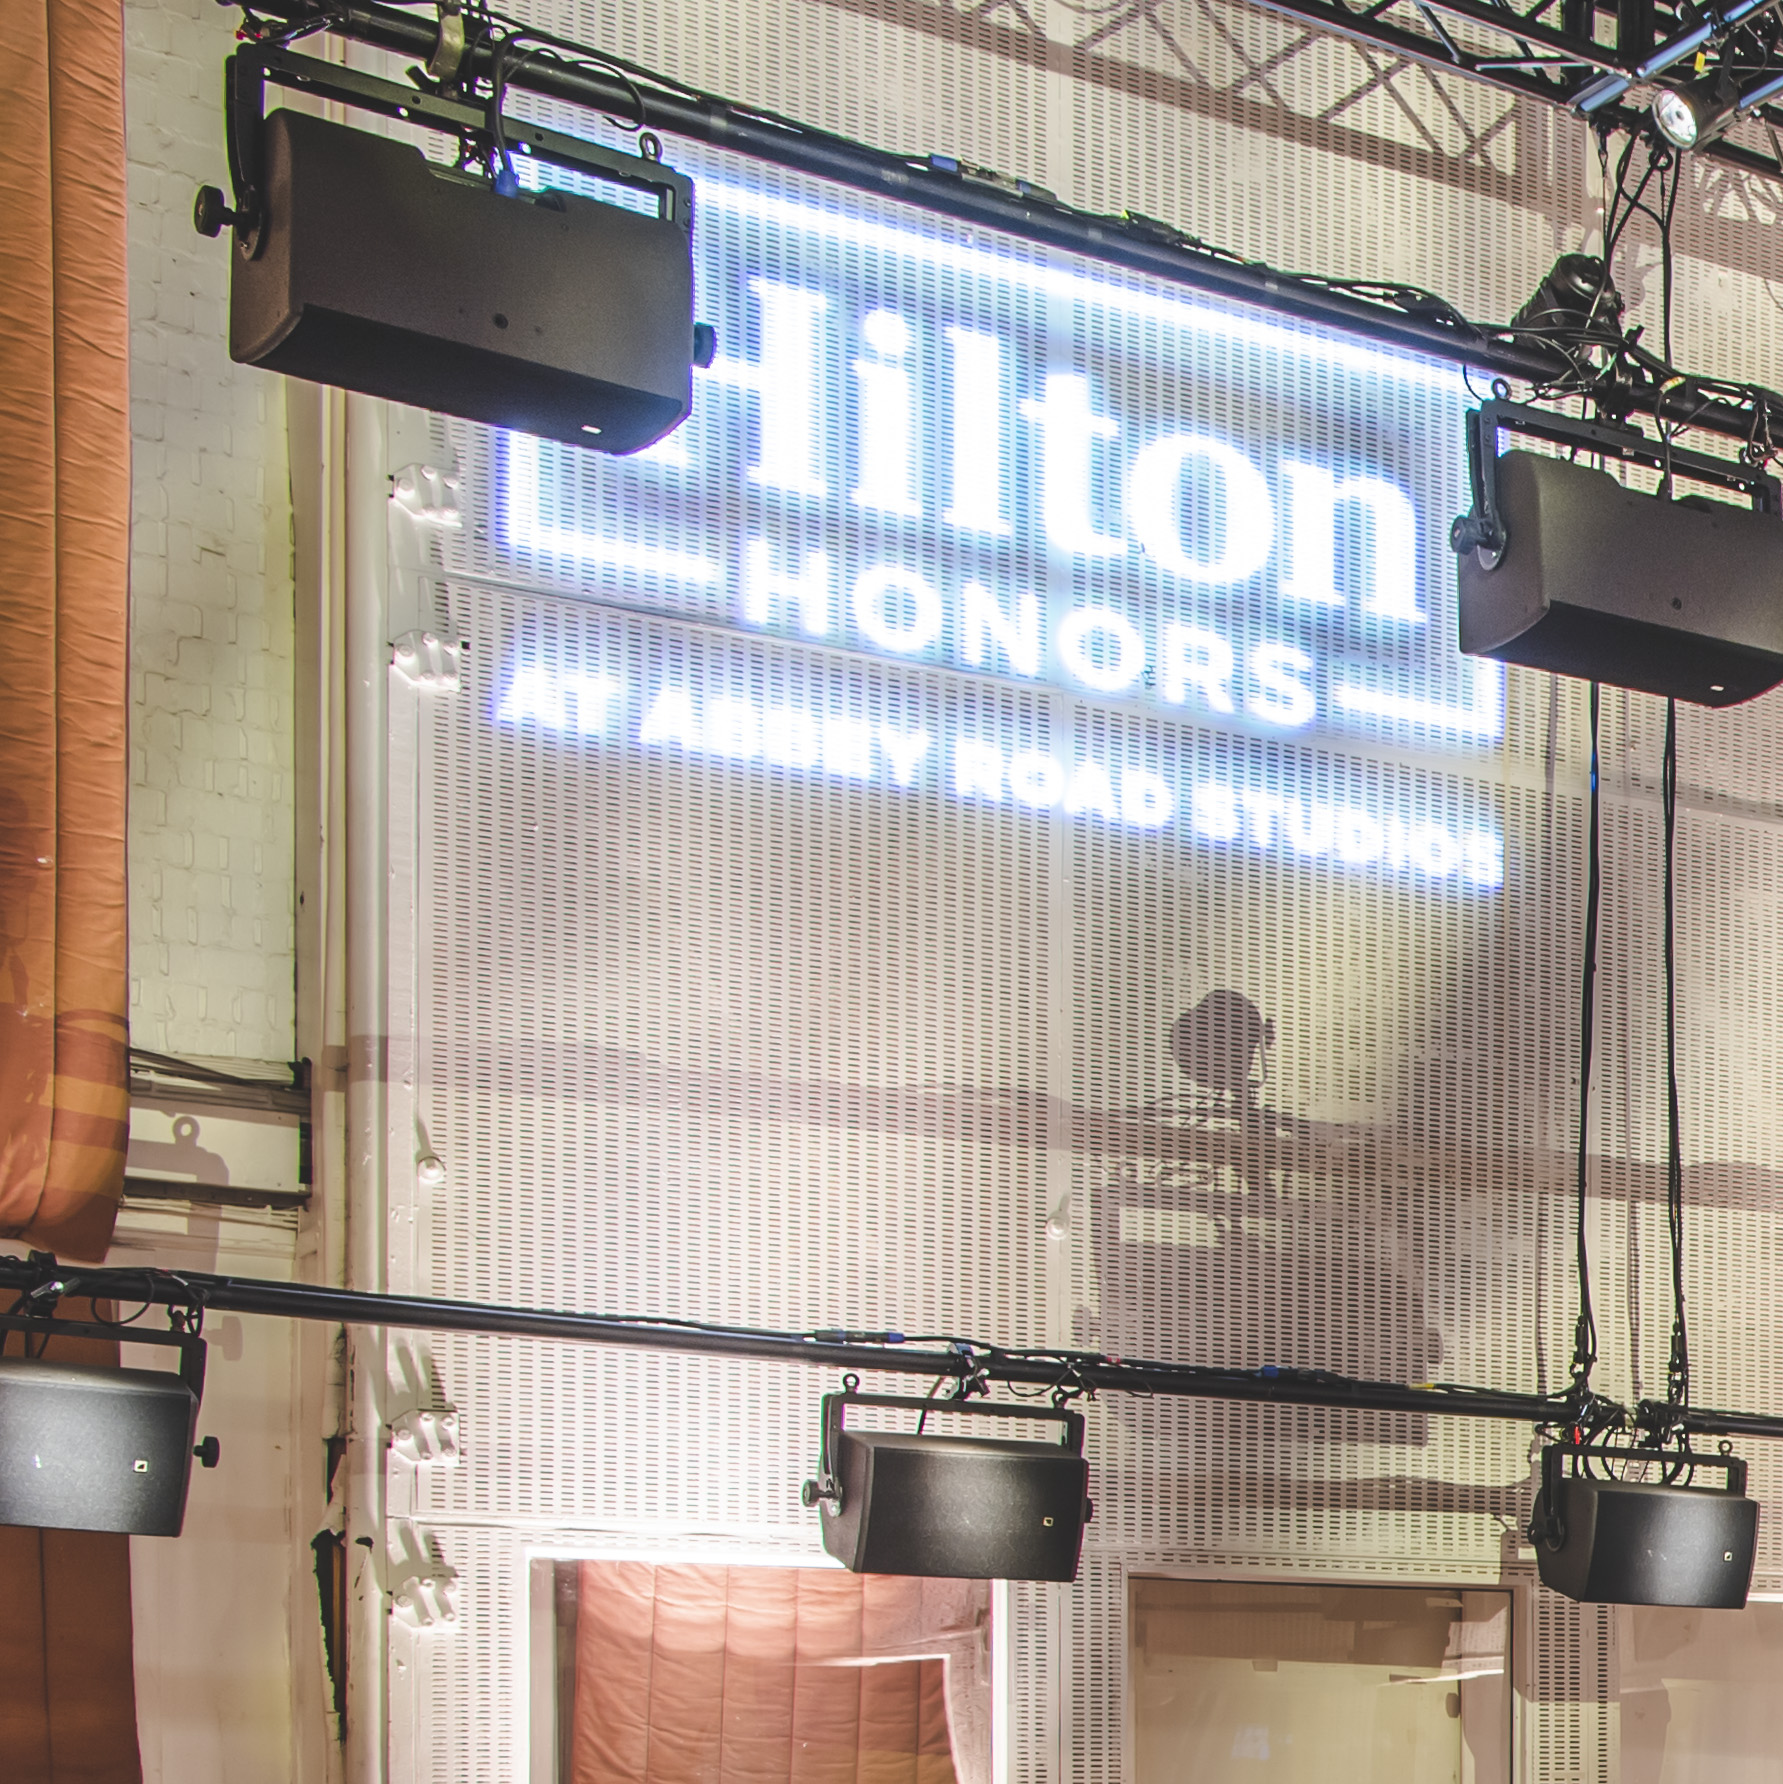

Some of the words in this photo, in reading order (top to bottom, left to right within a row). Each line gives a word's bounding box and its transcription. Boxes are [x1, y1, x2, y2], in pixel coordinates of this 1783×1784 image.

[742, 536, 1316, 731] HONORS
[497, 662, 620, 735] AT
[638, 686, 933, 788] ABBEY
[954, 735, 1175, 830] ROAD
[1192, 780, 1504, 890] STUDIOS
